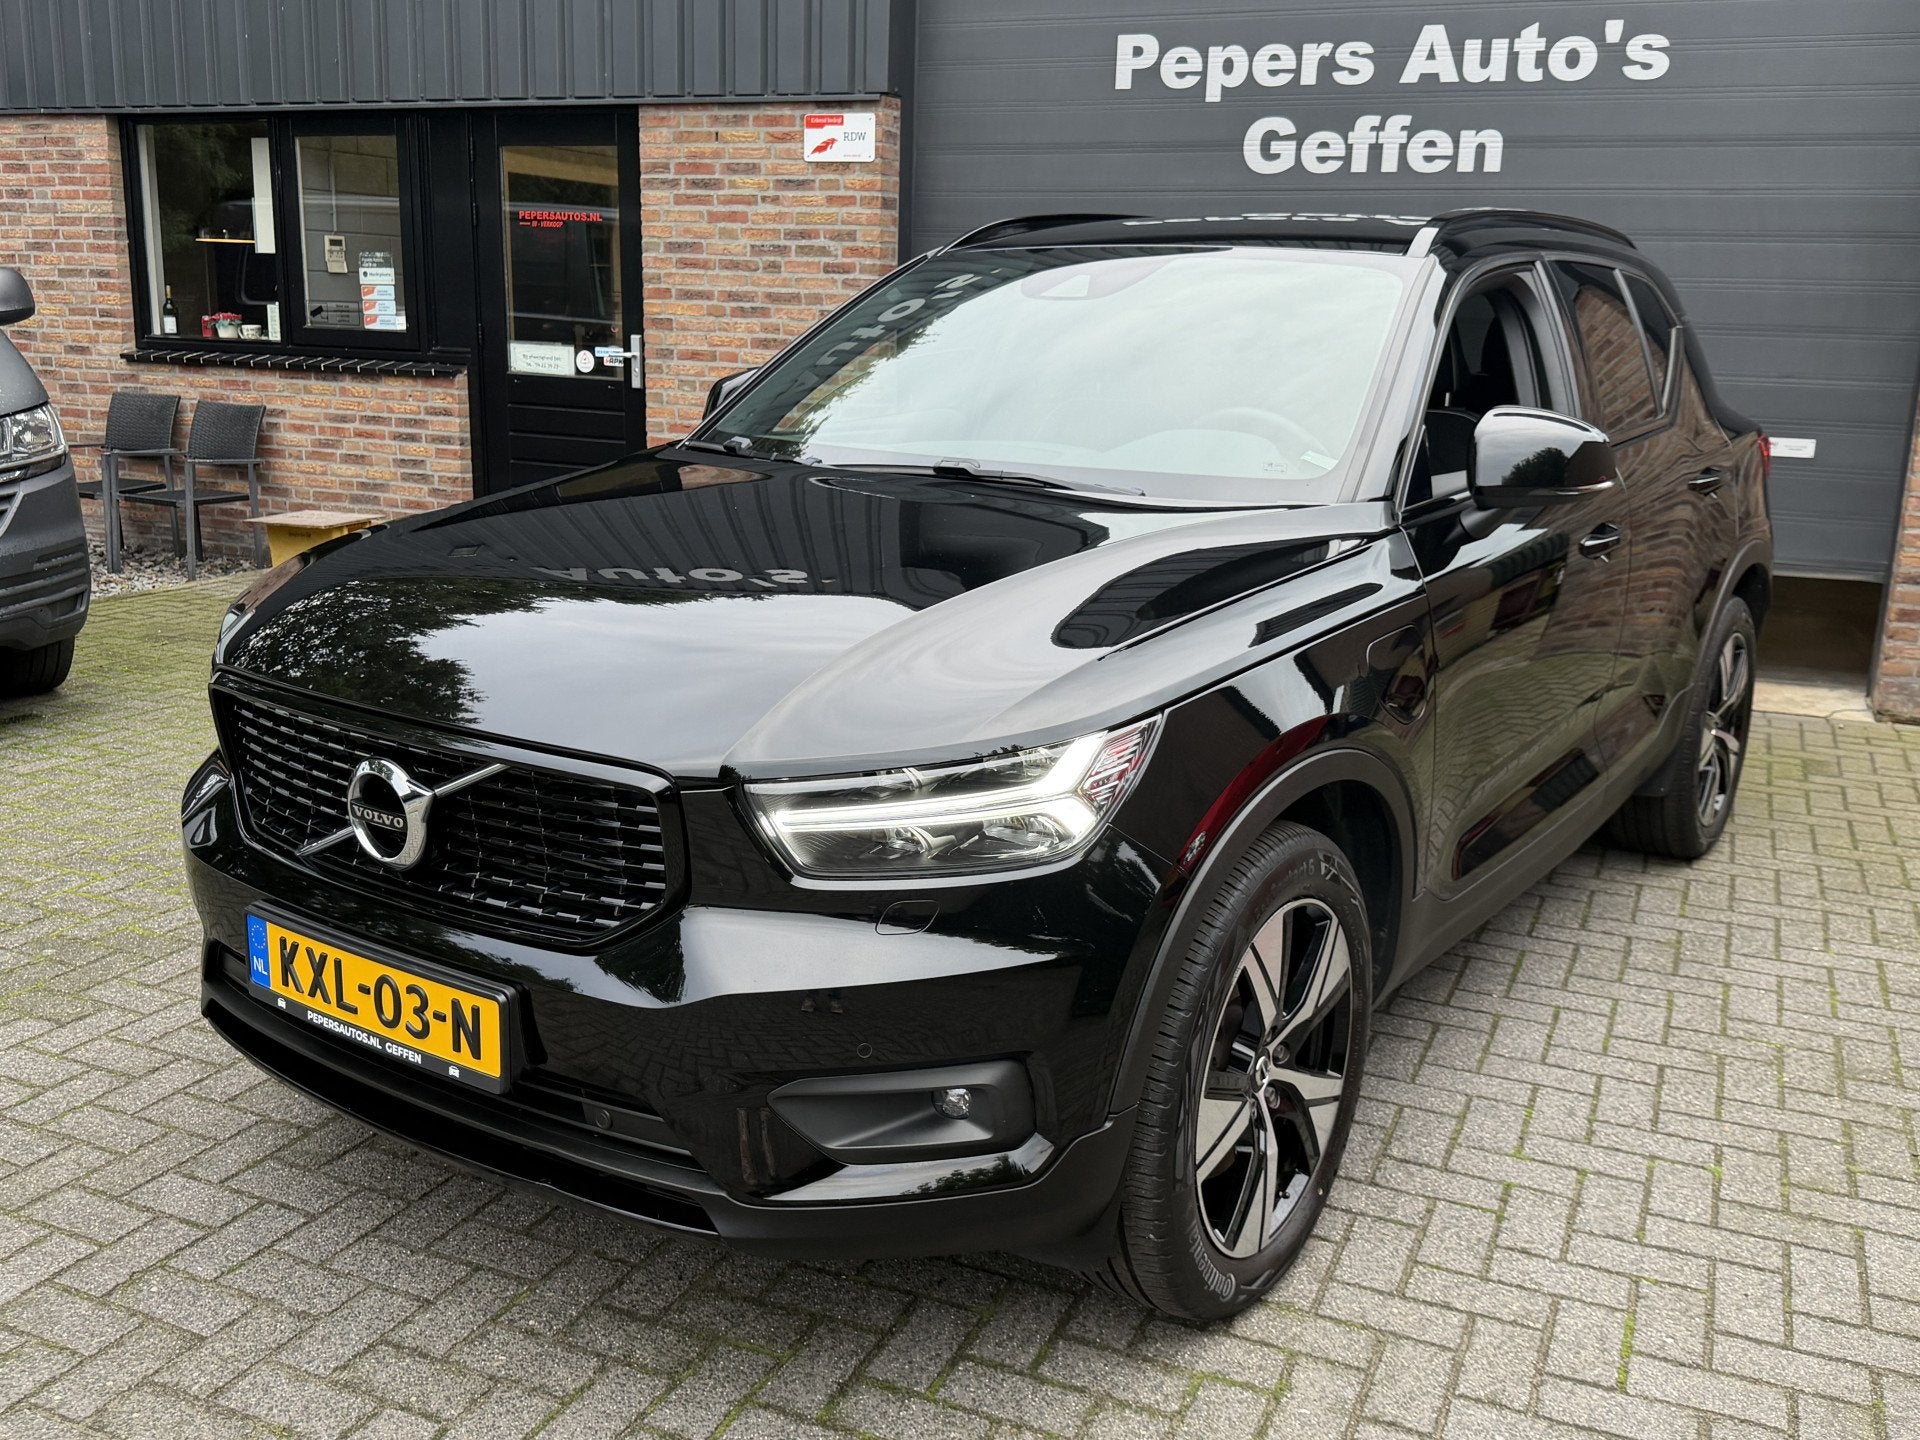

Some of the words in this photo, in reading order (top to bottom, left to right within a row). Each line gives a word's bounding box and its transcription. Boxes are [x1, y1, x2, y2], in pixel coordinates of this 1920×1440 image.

[1115, 33, 1375, 102] Pepers
[1400, 19, 1671, 83] Auto's
[843, 131, 866, 141] RDW
[1242, 114, 1503, 174] Geffen
[518, 210, 603, 222] PEPERSAUTOS.NL
[352, 804, 404, 828] VOLVO
[253, 955, 268, 976] NL
[279, 936, 481, 1061] KXL-03-N
[307, 1010, 382, 1050] PEPERSAUTOS.NL
[385, 1041, 422, 1065] GEFFEN
